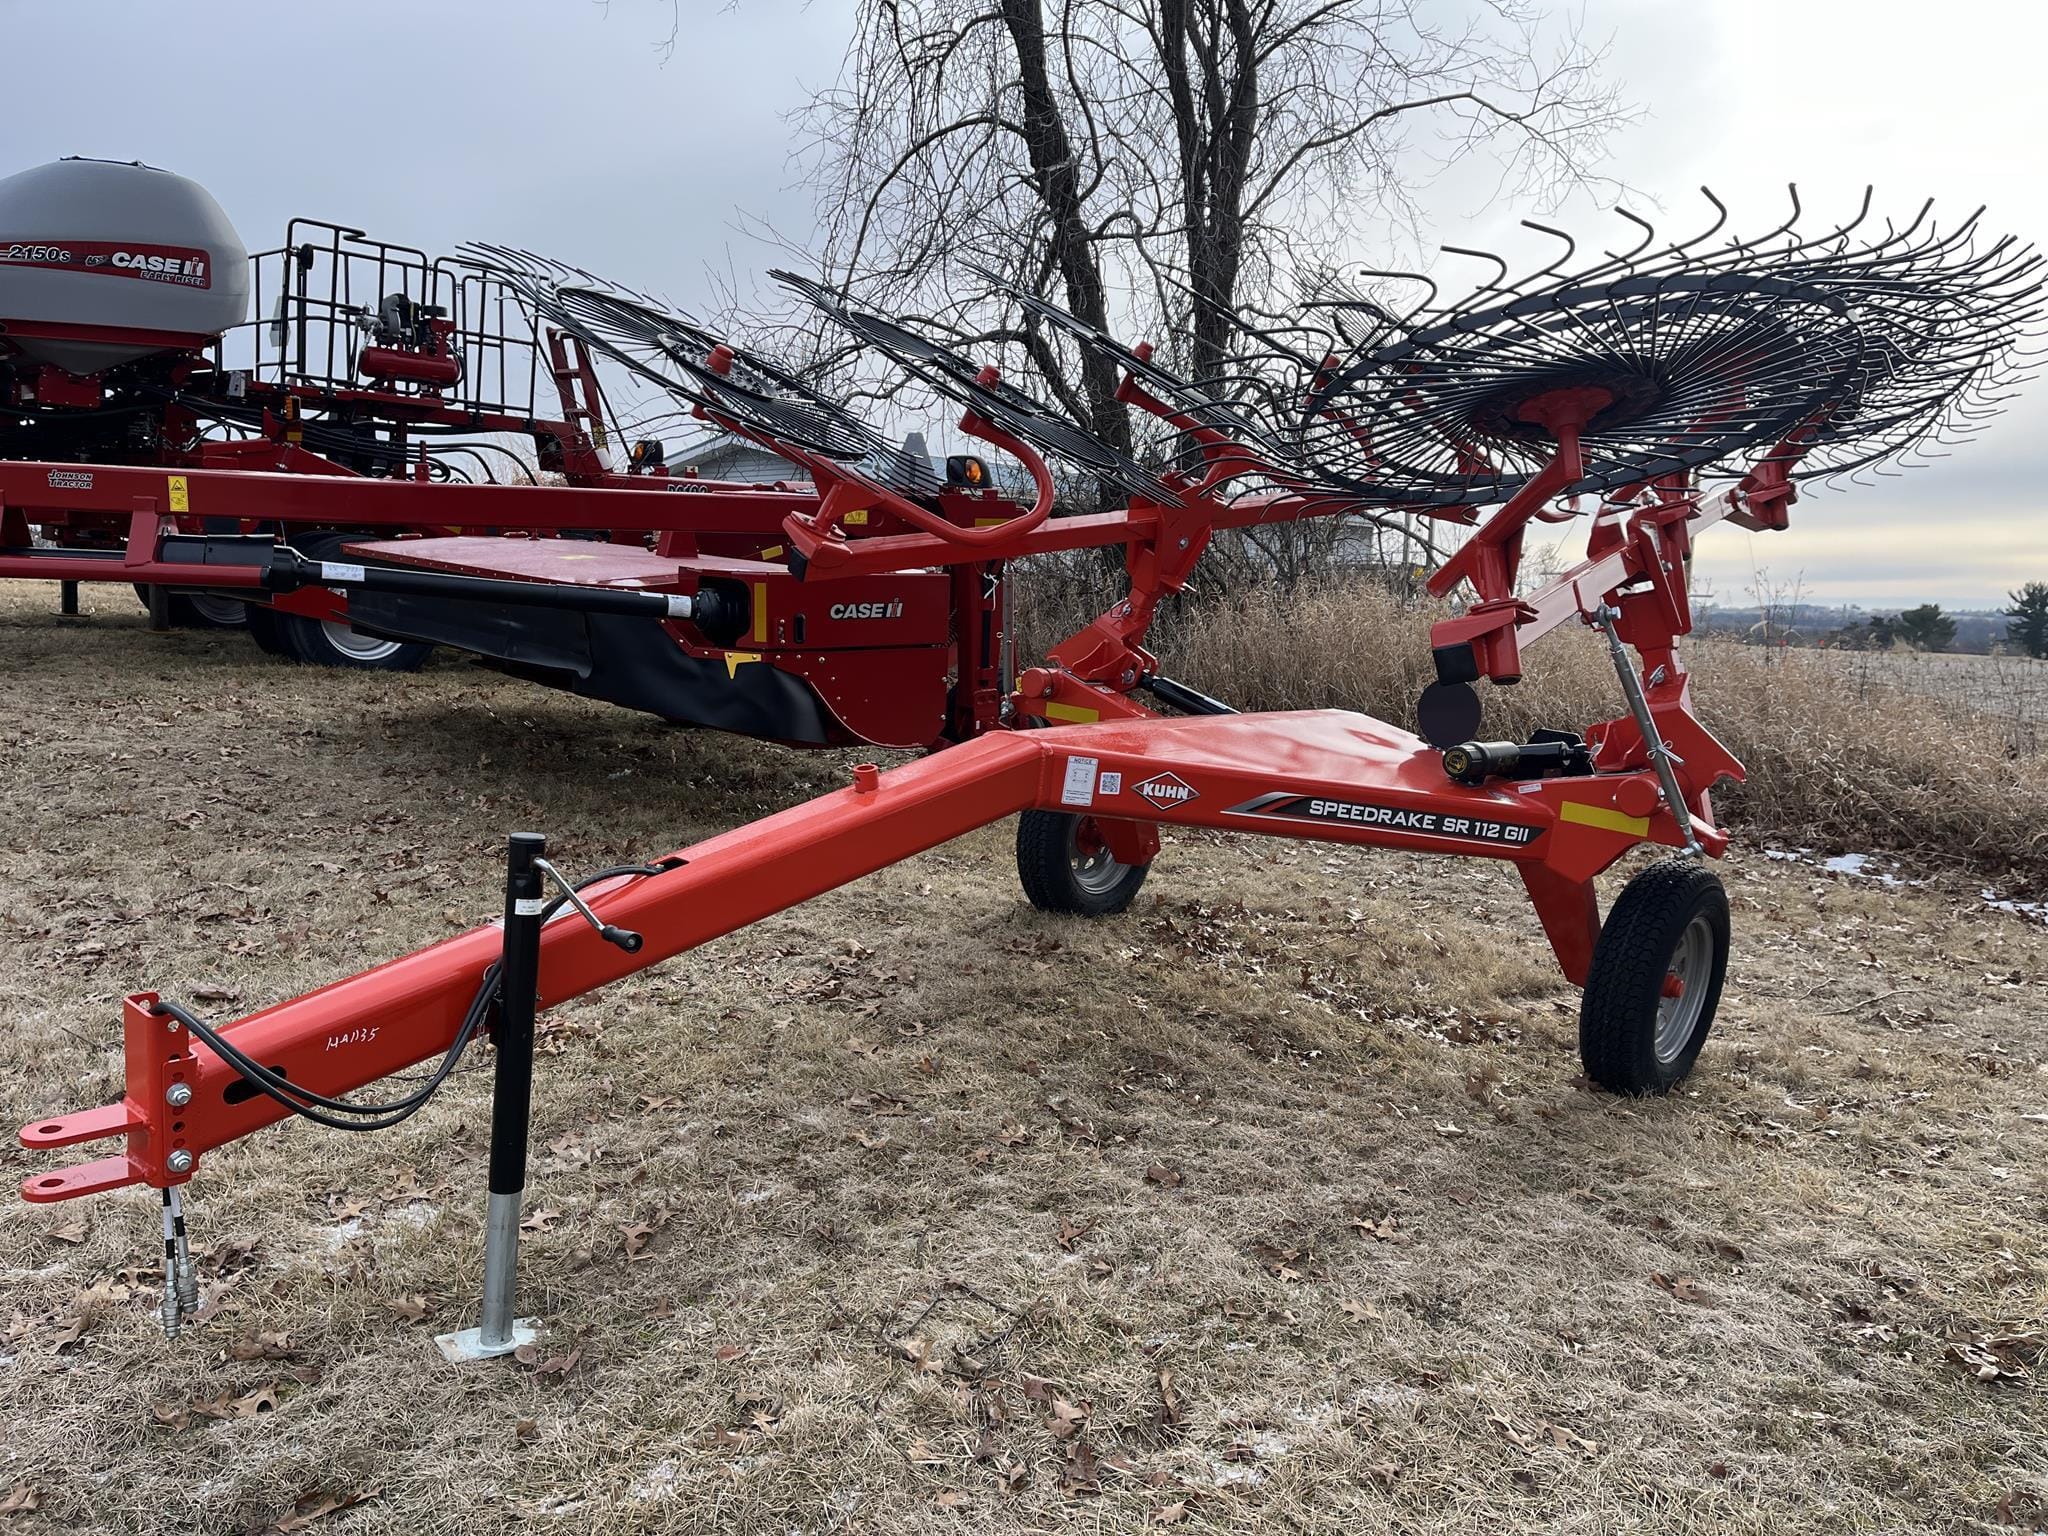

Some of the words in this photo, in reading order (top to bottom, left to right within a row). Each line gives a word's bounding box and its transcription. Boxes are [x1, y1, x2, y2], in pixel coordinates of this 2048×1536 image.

[8, 245, 71, 263] 2150s
[111, 252, 181, 273] CASE
[140, 270, 175, 282] EARLY
[175, 274, 205, 286] RISER
[48, 469, 93, 480] JOHNSON
[49, 479, 92, 489] TRACTOR
[830, 603, 884, 619] CASE
[1143, 783, 1188, 800] KUHN
[1309, 800, 1436, 830] SPEEDRAKE
[1442, 817, 1469, 834] SR
[1474, 822, 1500, 838] 112
[1504, 826, 1529, 842] GII
